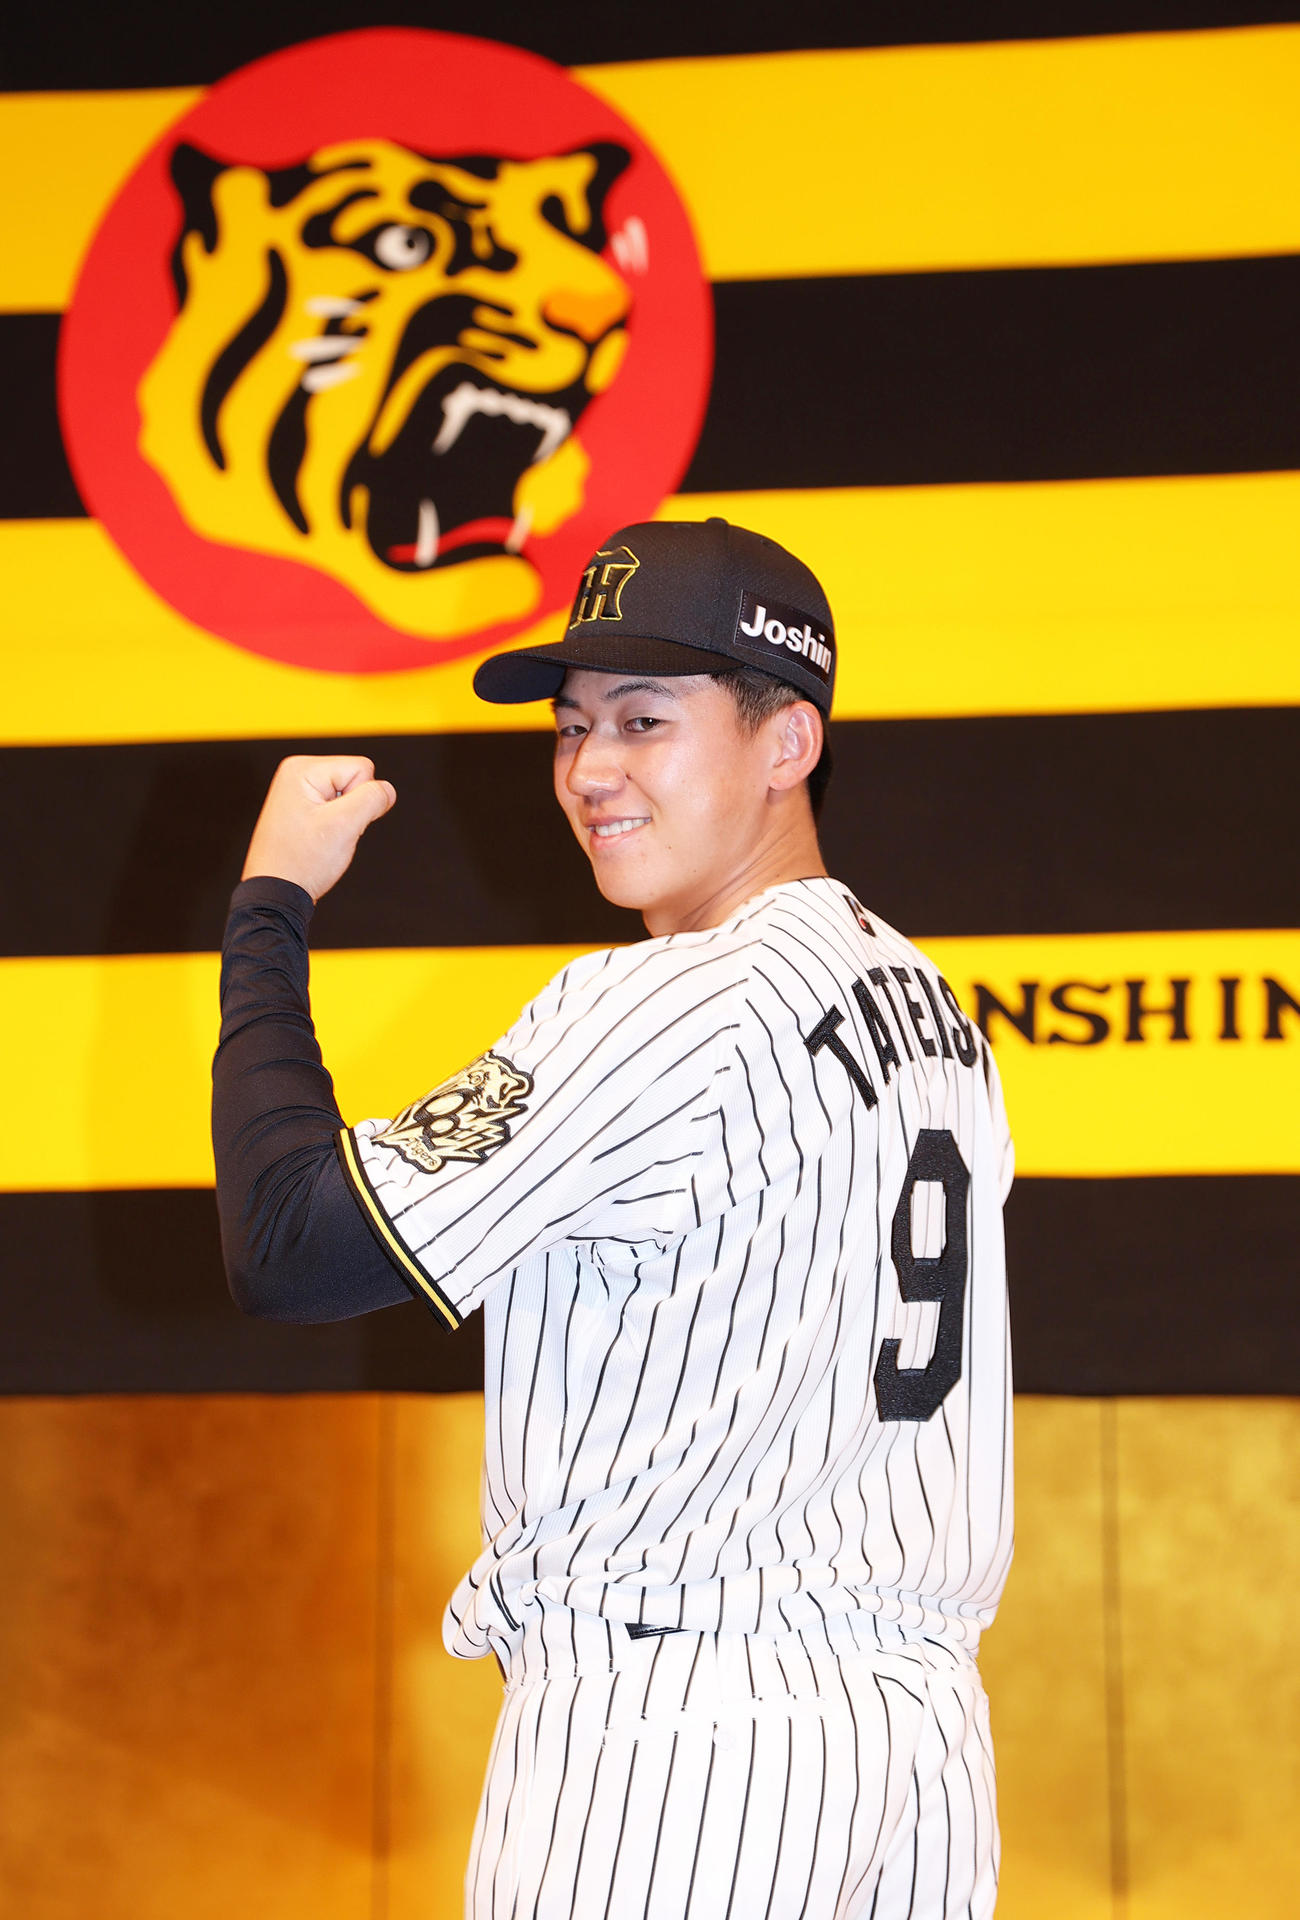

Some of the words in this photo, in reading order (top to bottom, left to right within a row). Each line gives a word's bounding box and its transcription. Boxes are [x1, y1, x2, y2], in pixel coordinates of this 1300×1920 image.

[740, 605, 833, 674] Joshin
[804, 966, 990, 1111] TATEIS
[873, 1129, 970, 1422] 9
